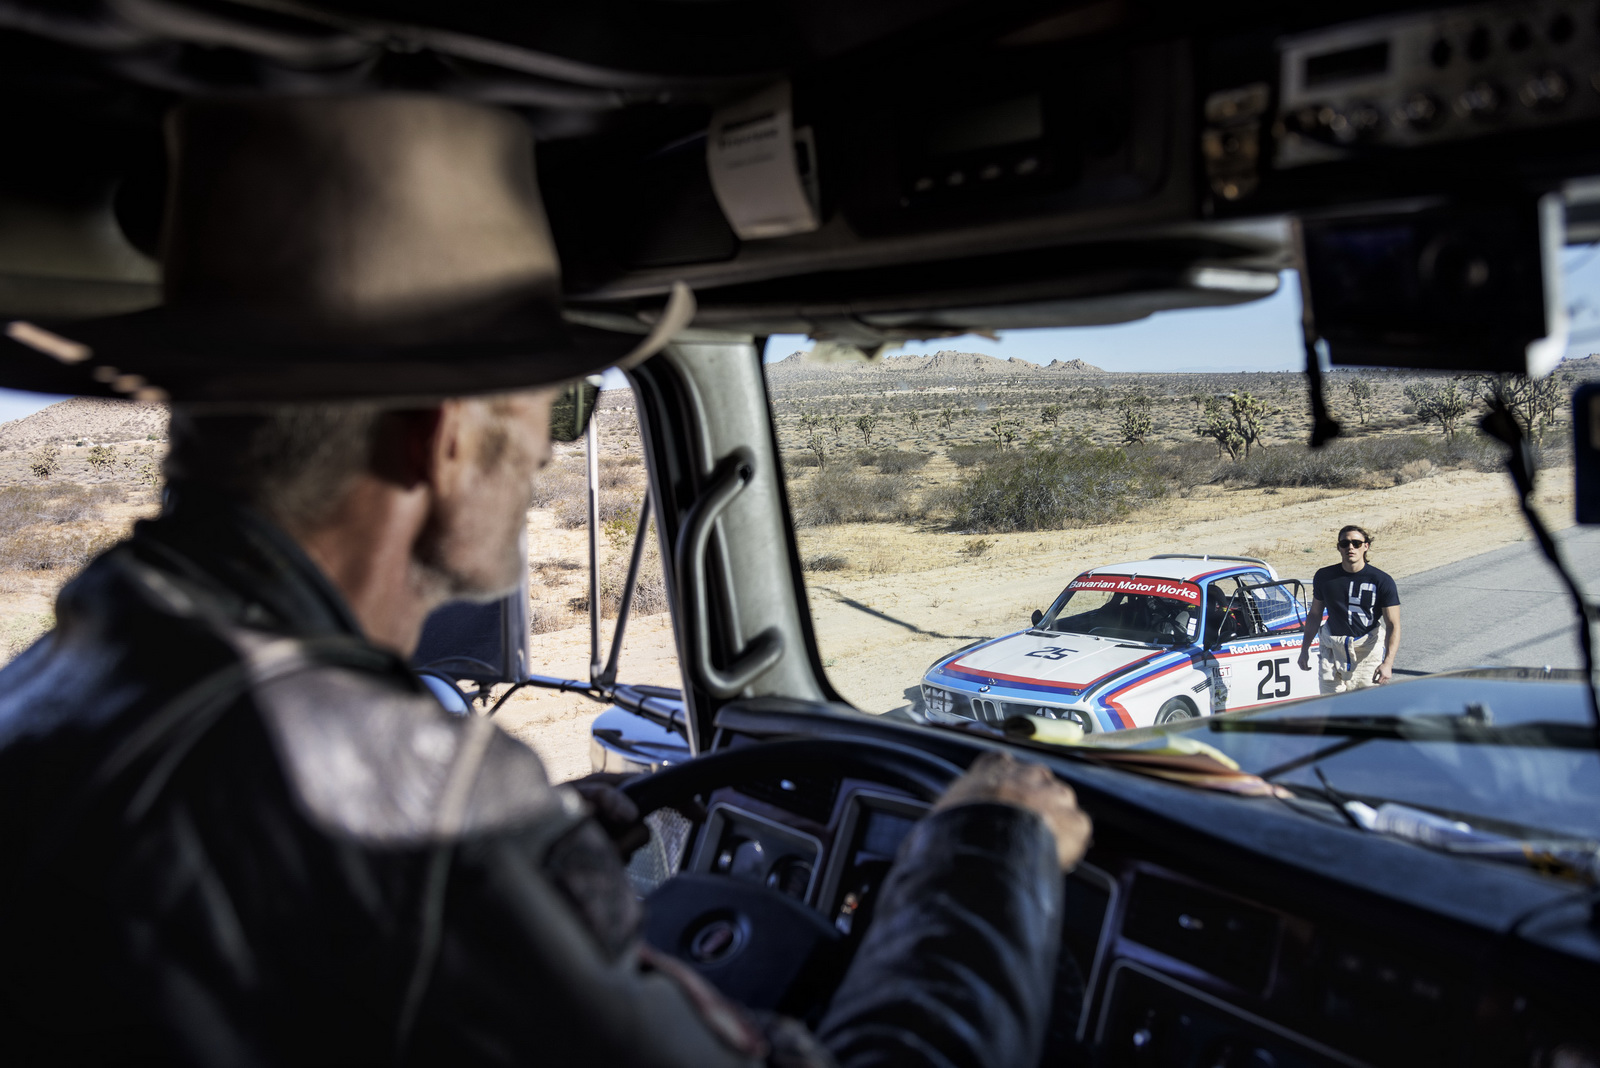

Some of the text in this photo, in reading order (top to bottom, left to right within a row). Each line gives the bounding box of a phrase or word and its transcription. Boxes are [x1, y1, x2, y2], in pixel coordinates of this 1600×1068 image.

[1068, 579, 1198, 599] Bavarian Motor Works
[1024, 646, 1079, 660] 25
[1229, 642, 1272, 655] Redman
[1257, 657, 1291, 700] 25
